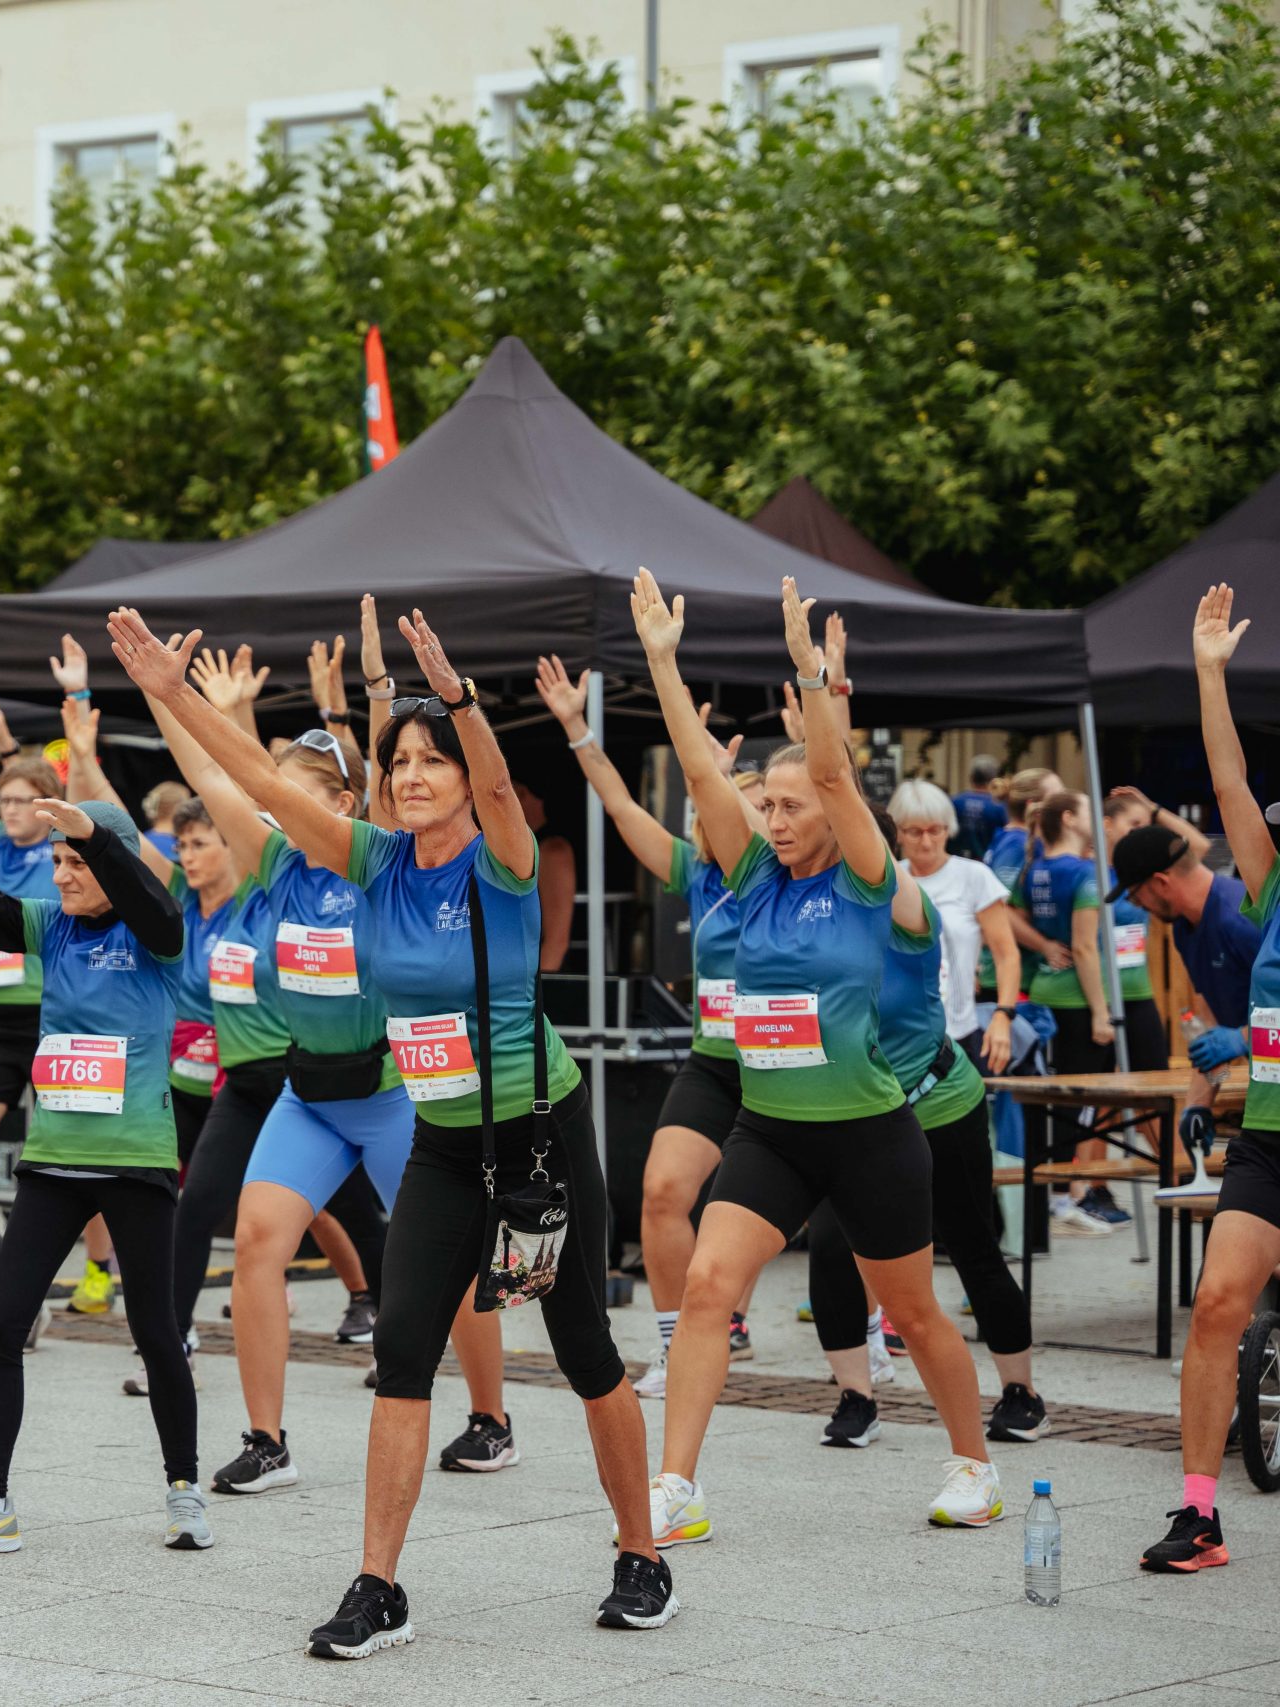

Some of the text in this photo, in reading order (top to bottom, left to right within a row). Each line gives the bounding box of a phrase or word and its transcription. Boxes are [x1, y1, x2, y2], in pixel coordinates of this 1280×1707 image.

[294, 945, 329, 963] Jana
[754, 1024, 795, 1033] ANGELINA
[1268, 1030, 1280, 1046] P
[399, 1043, 449, 1069] 1765
[48, 1059, 102, 1082] 1766
